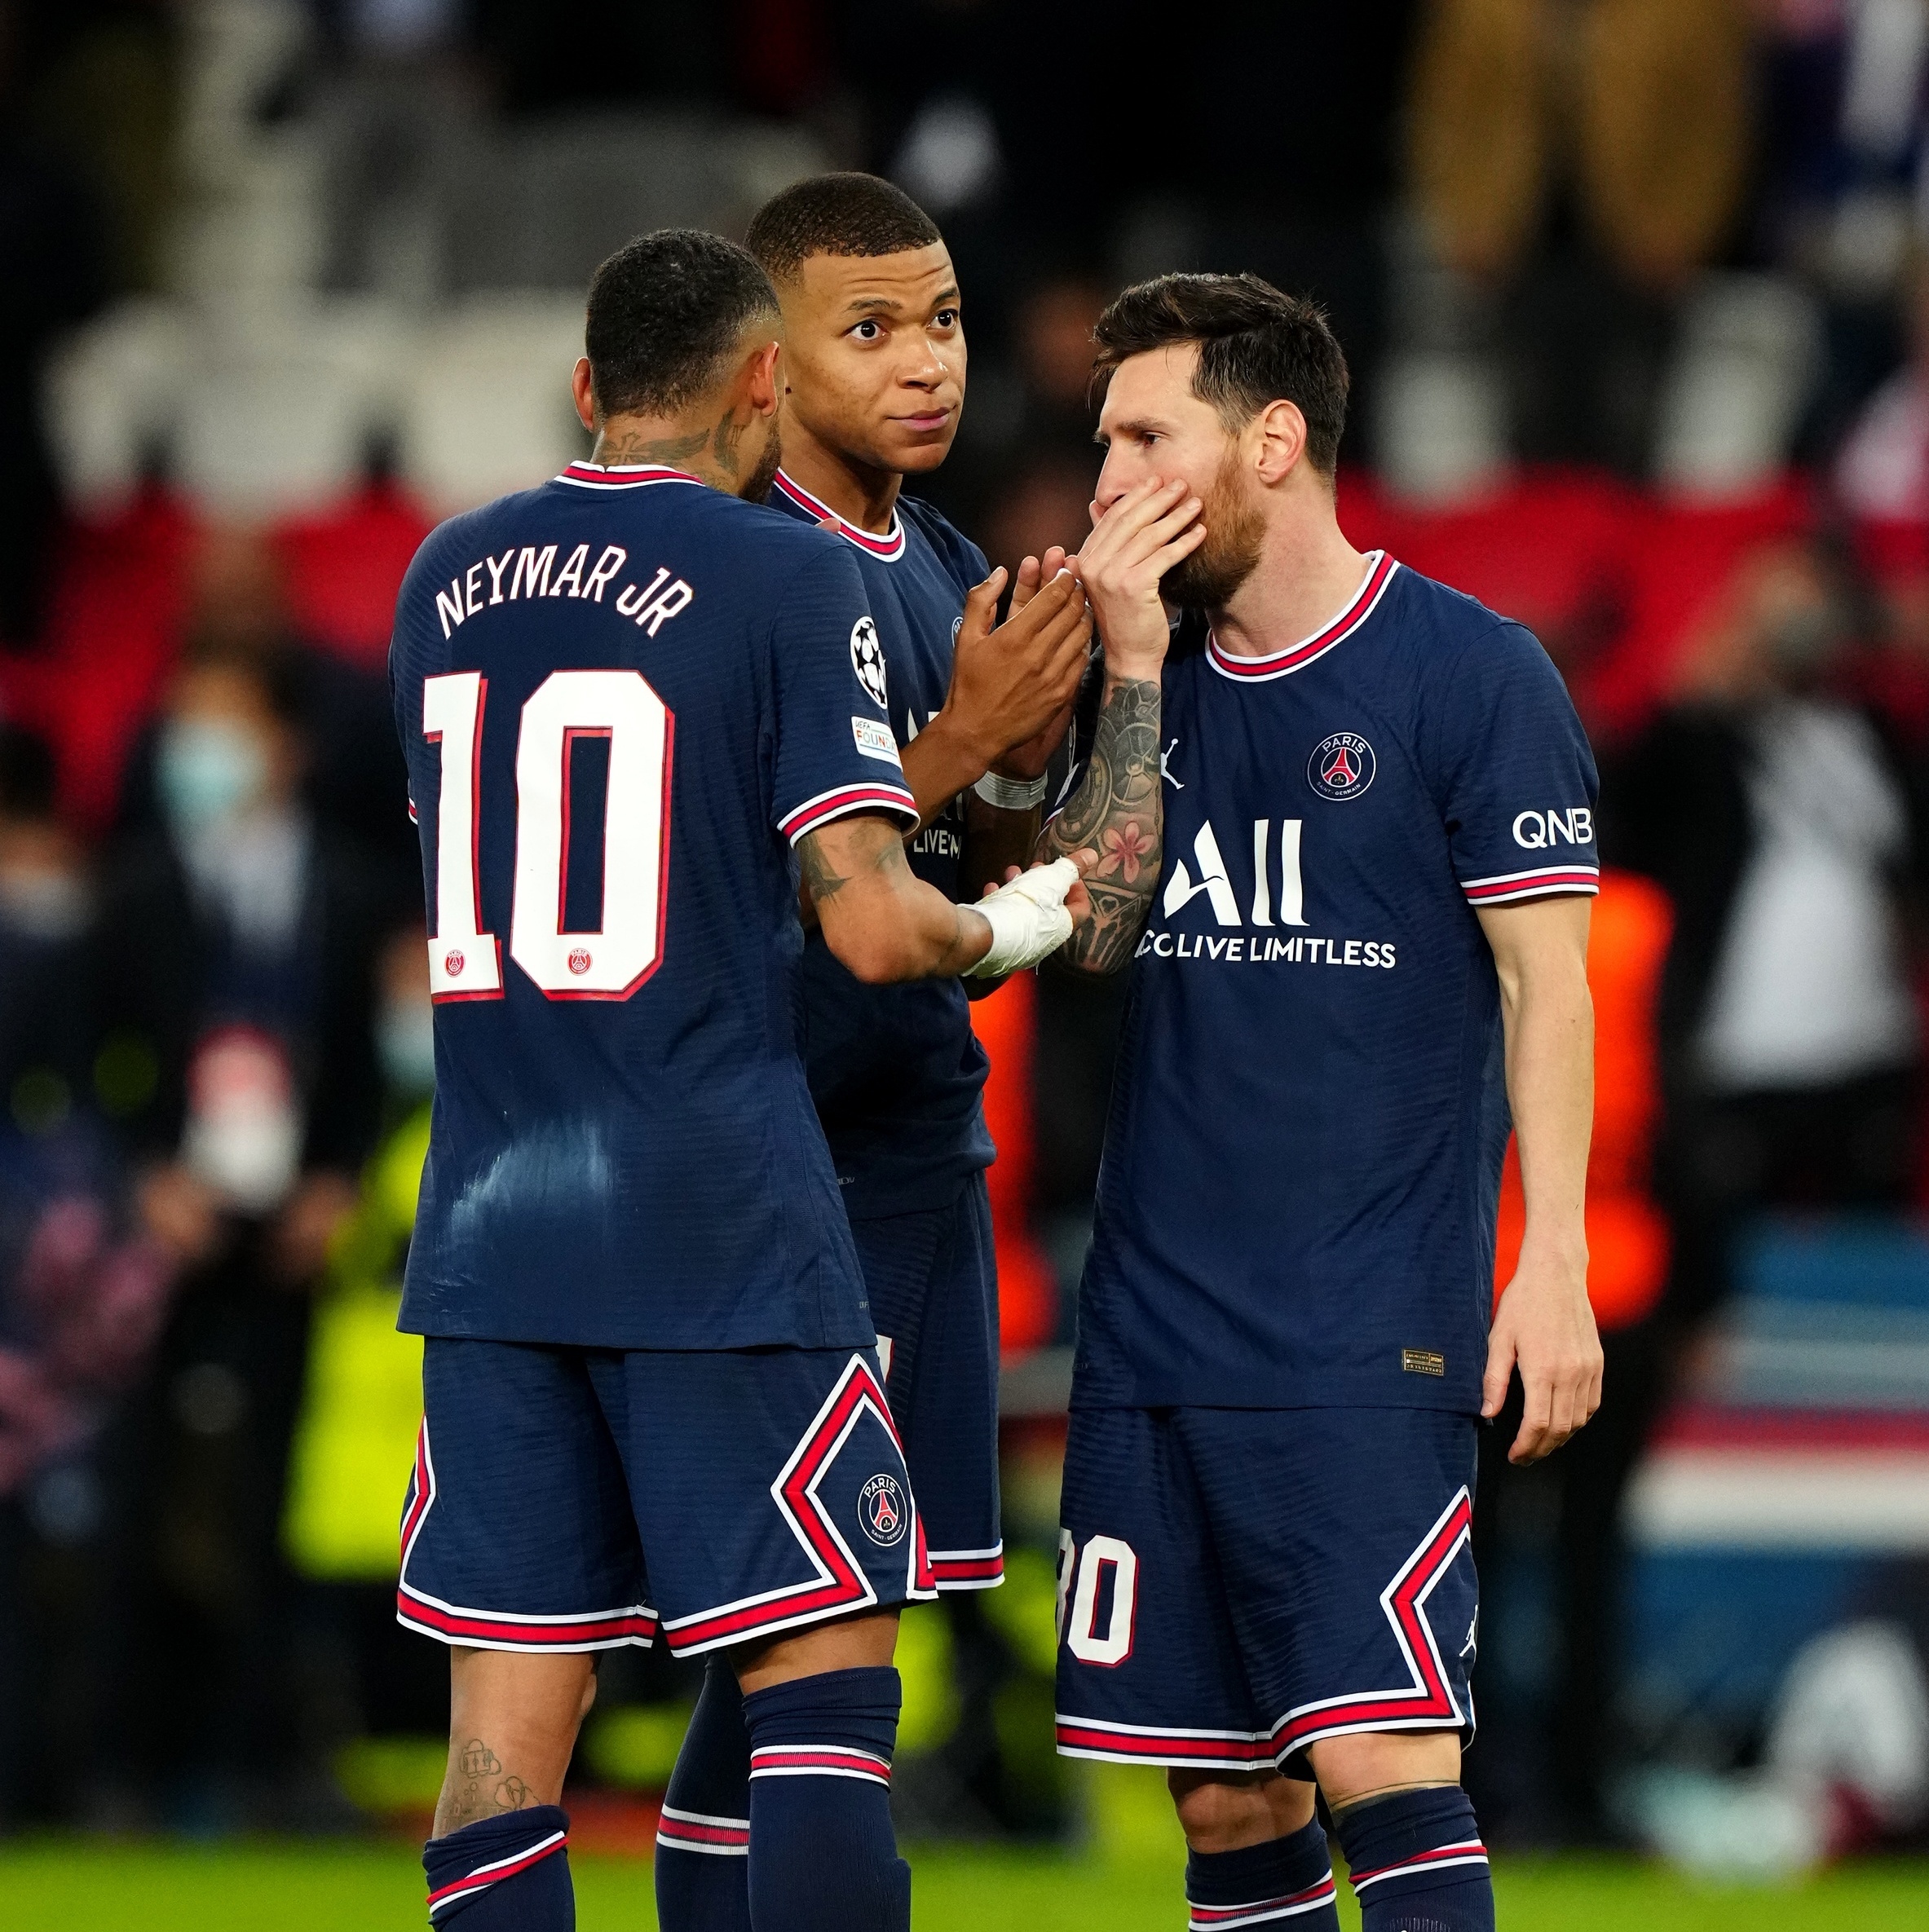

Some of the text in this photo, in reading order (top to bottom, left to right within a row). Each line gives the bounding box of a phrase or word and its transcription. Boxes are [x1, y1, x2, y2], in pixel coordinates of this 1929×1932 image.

[435, 543, 694, 641] NEYMAR JR
[855, 720, 871, 730] UEFA
[1322, 735, 1366, 754] PARIS
[421, 670, 675, 1002] 10
[1512, 807, 1594, 850] QNB
[1176, 933, 1245, 962] LIVE
[1250, 937, 1397, 969] LIMITLESS
[864, 1477, 896, 1498] PARIS
